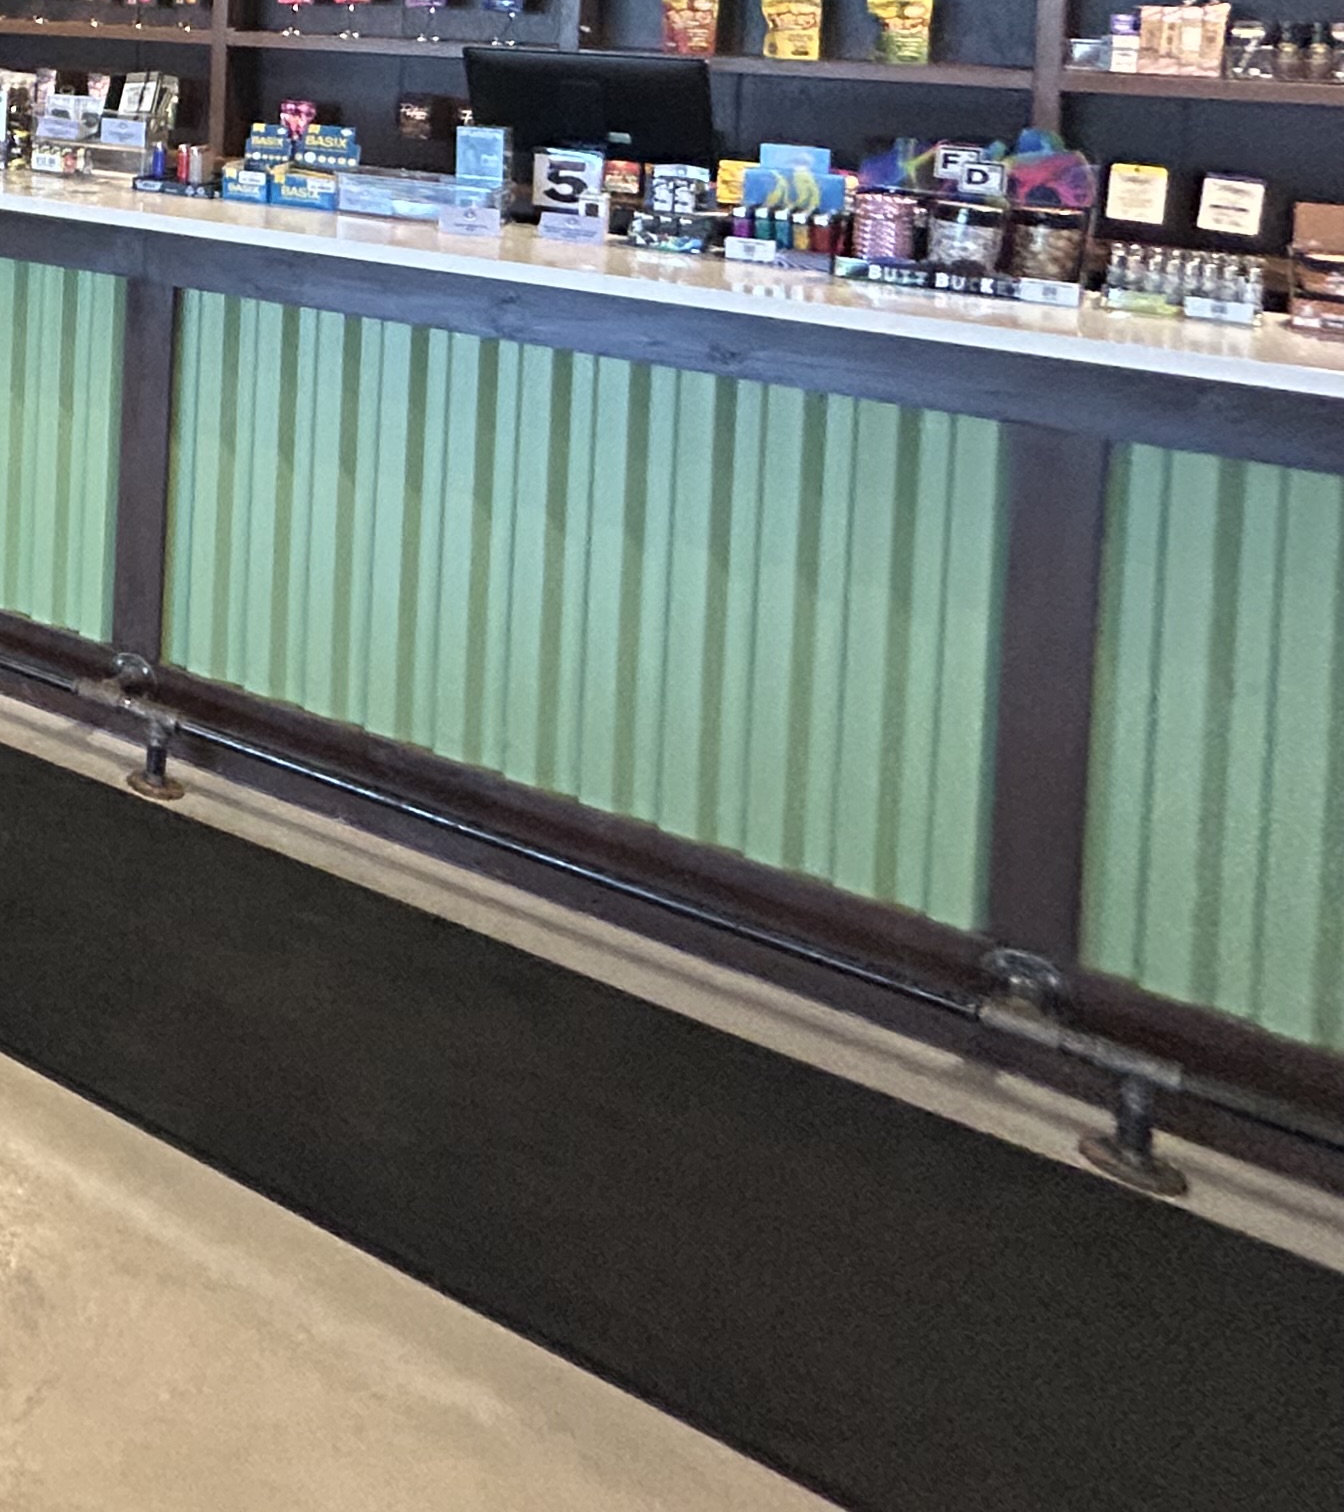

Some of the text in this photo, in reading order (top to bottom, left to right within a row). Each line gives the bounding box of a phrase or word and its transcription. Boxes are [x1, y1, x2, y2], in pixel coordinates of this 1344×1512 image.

[304, 135, 348, 149] BASIX
[542, 160, 588, 204] 5
[941, 153, 989, 186] F D
